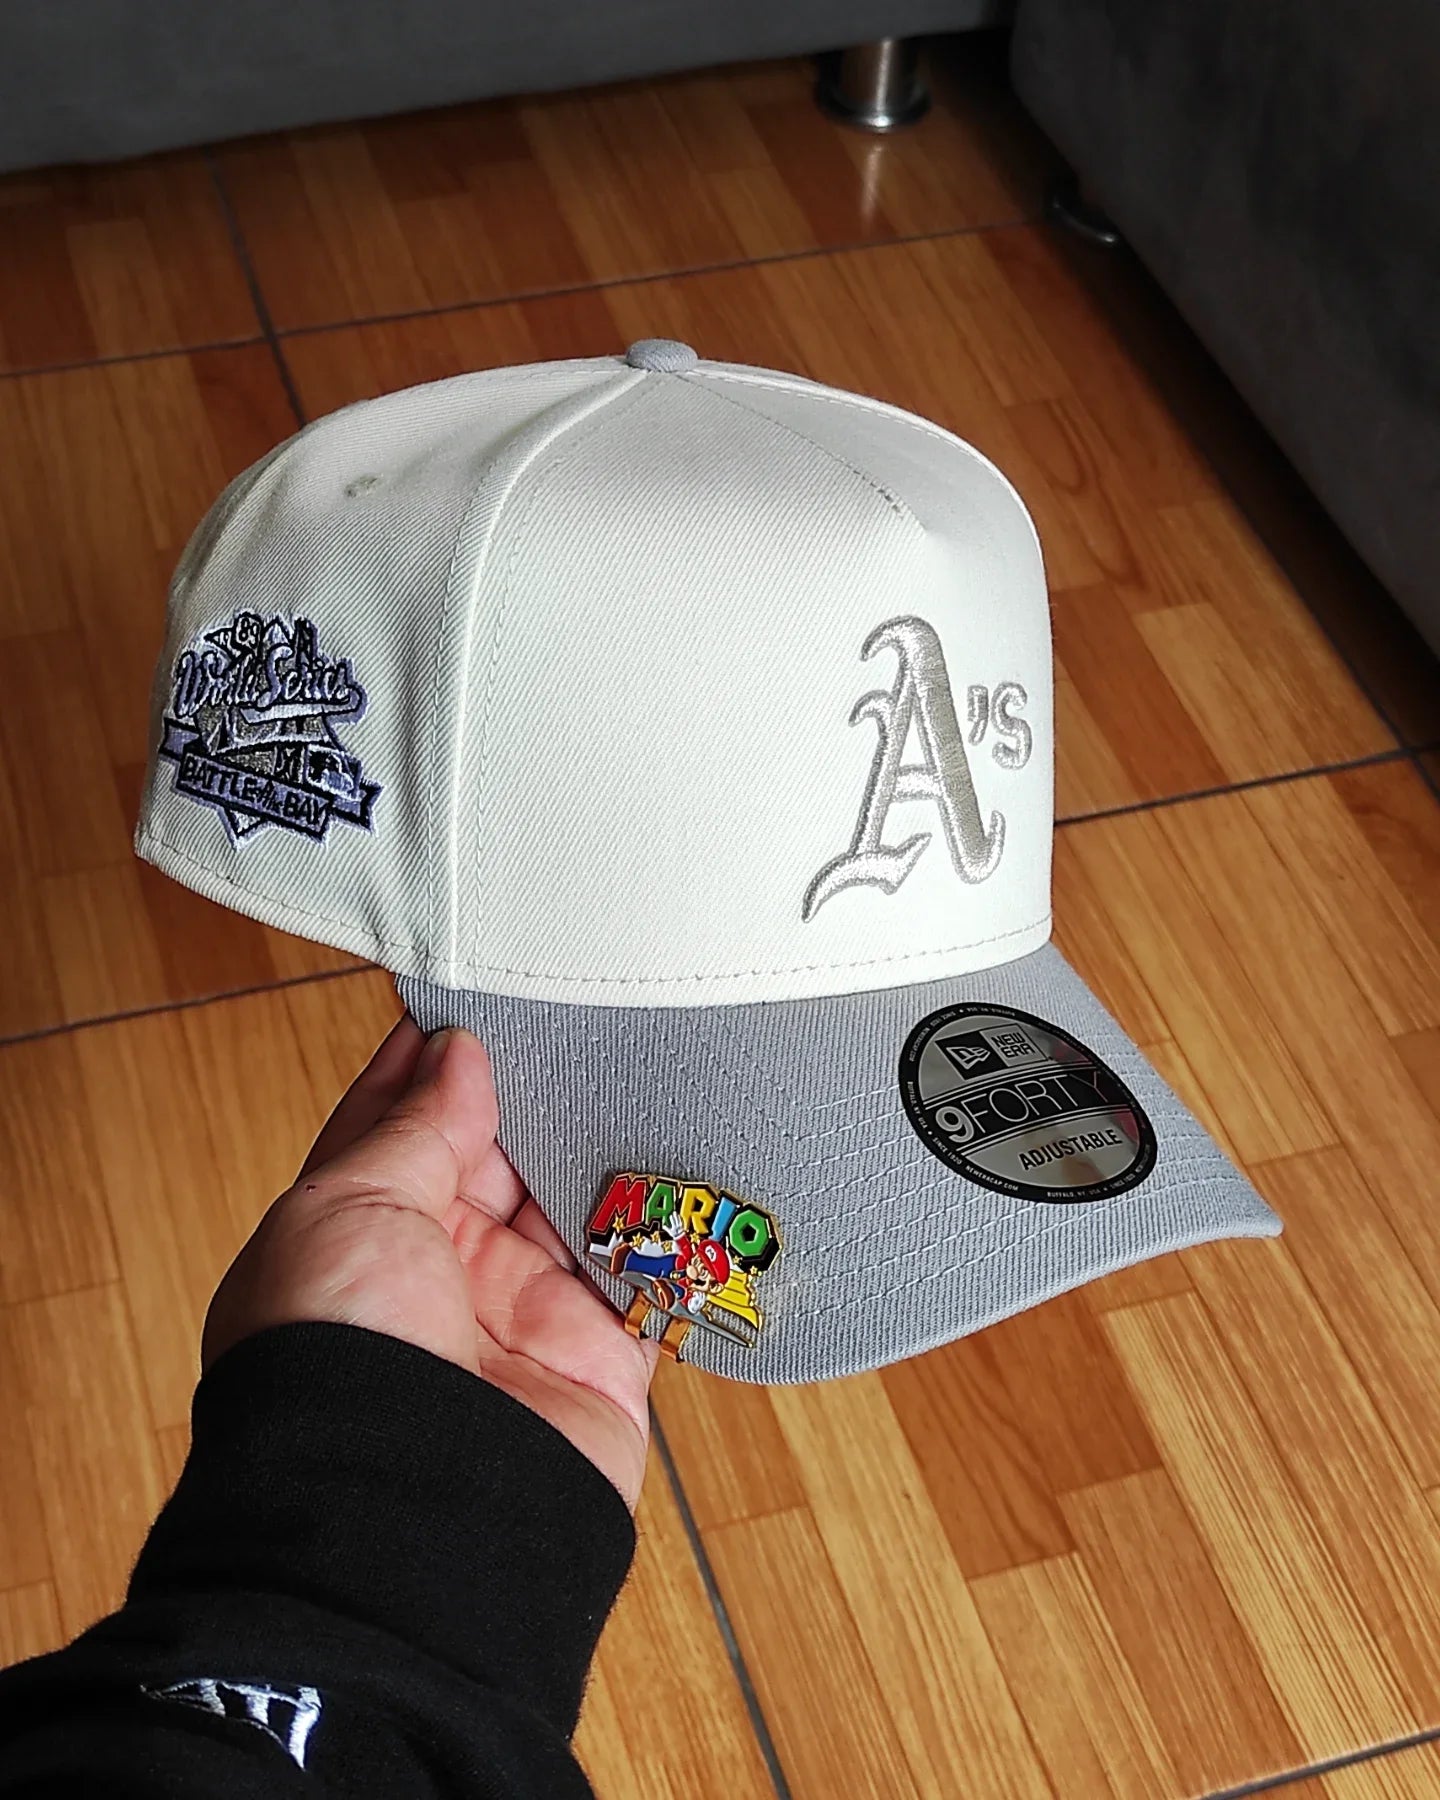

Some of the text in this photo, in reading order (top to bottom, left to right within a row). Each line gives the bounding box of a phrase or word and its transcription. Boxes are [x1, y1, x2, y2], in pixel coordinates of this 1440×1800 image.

[990, 1030, 1026, 1049] NEW
[1002, 1043, 1037, 1060] ERA
[934, 1072, 1110, 1144] 9FORTY
[1017, 1128, 1124, 1171] ADJUSTABLE
[590, 1177, 776, 1264] MARIO
